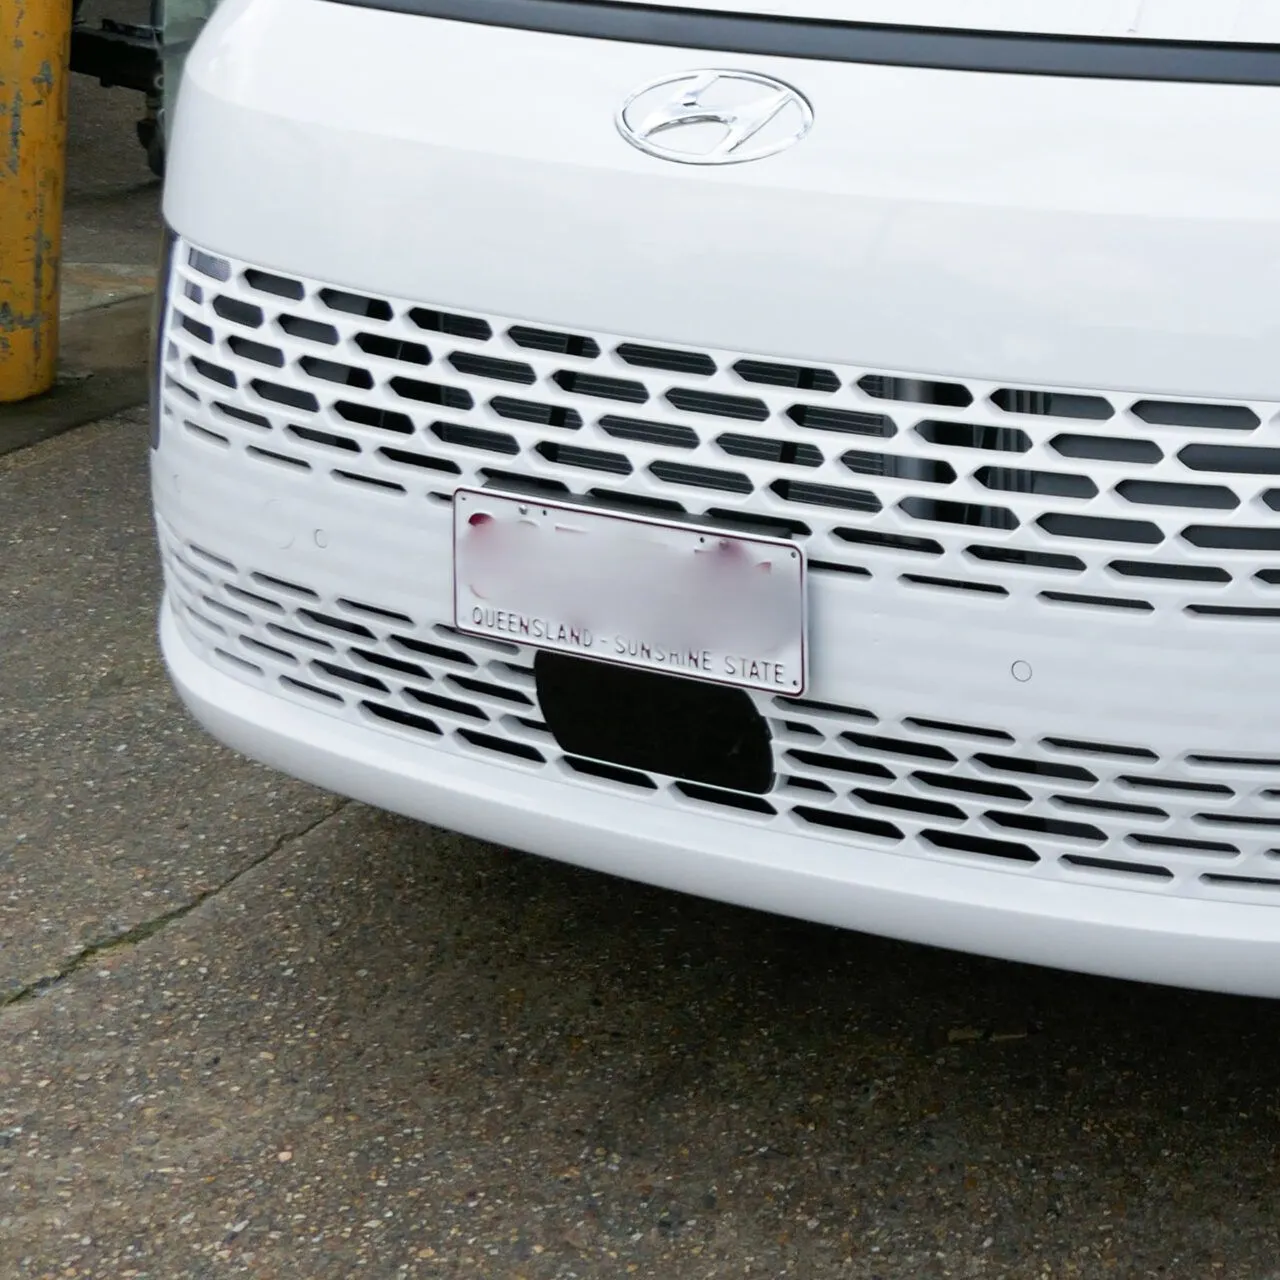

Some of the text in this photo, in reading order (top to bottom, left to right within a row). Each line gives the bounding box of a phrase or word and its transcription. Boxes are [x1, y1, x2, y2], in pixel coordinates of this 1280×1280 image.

[471, 605, 594, 649] QUEENSLAND
[615, 636, 713, 672] SUNSHINE
[724, 654, 786, 686] STATE
